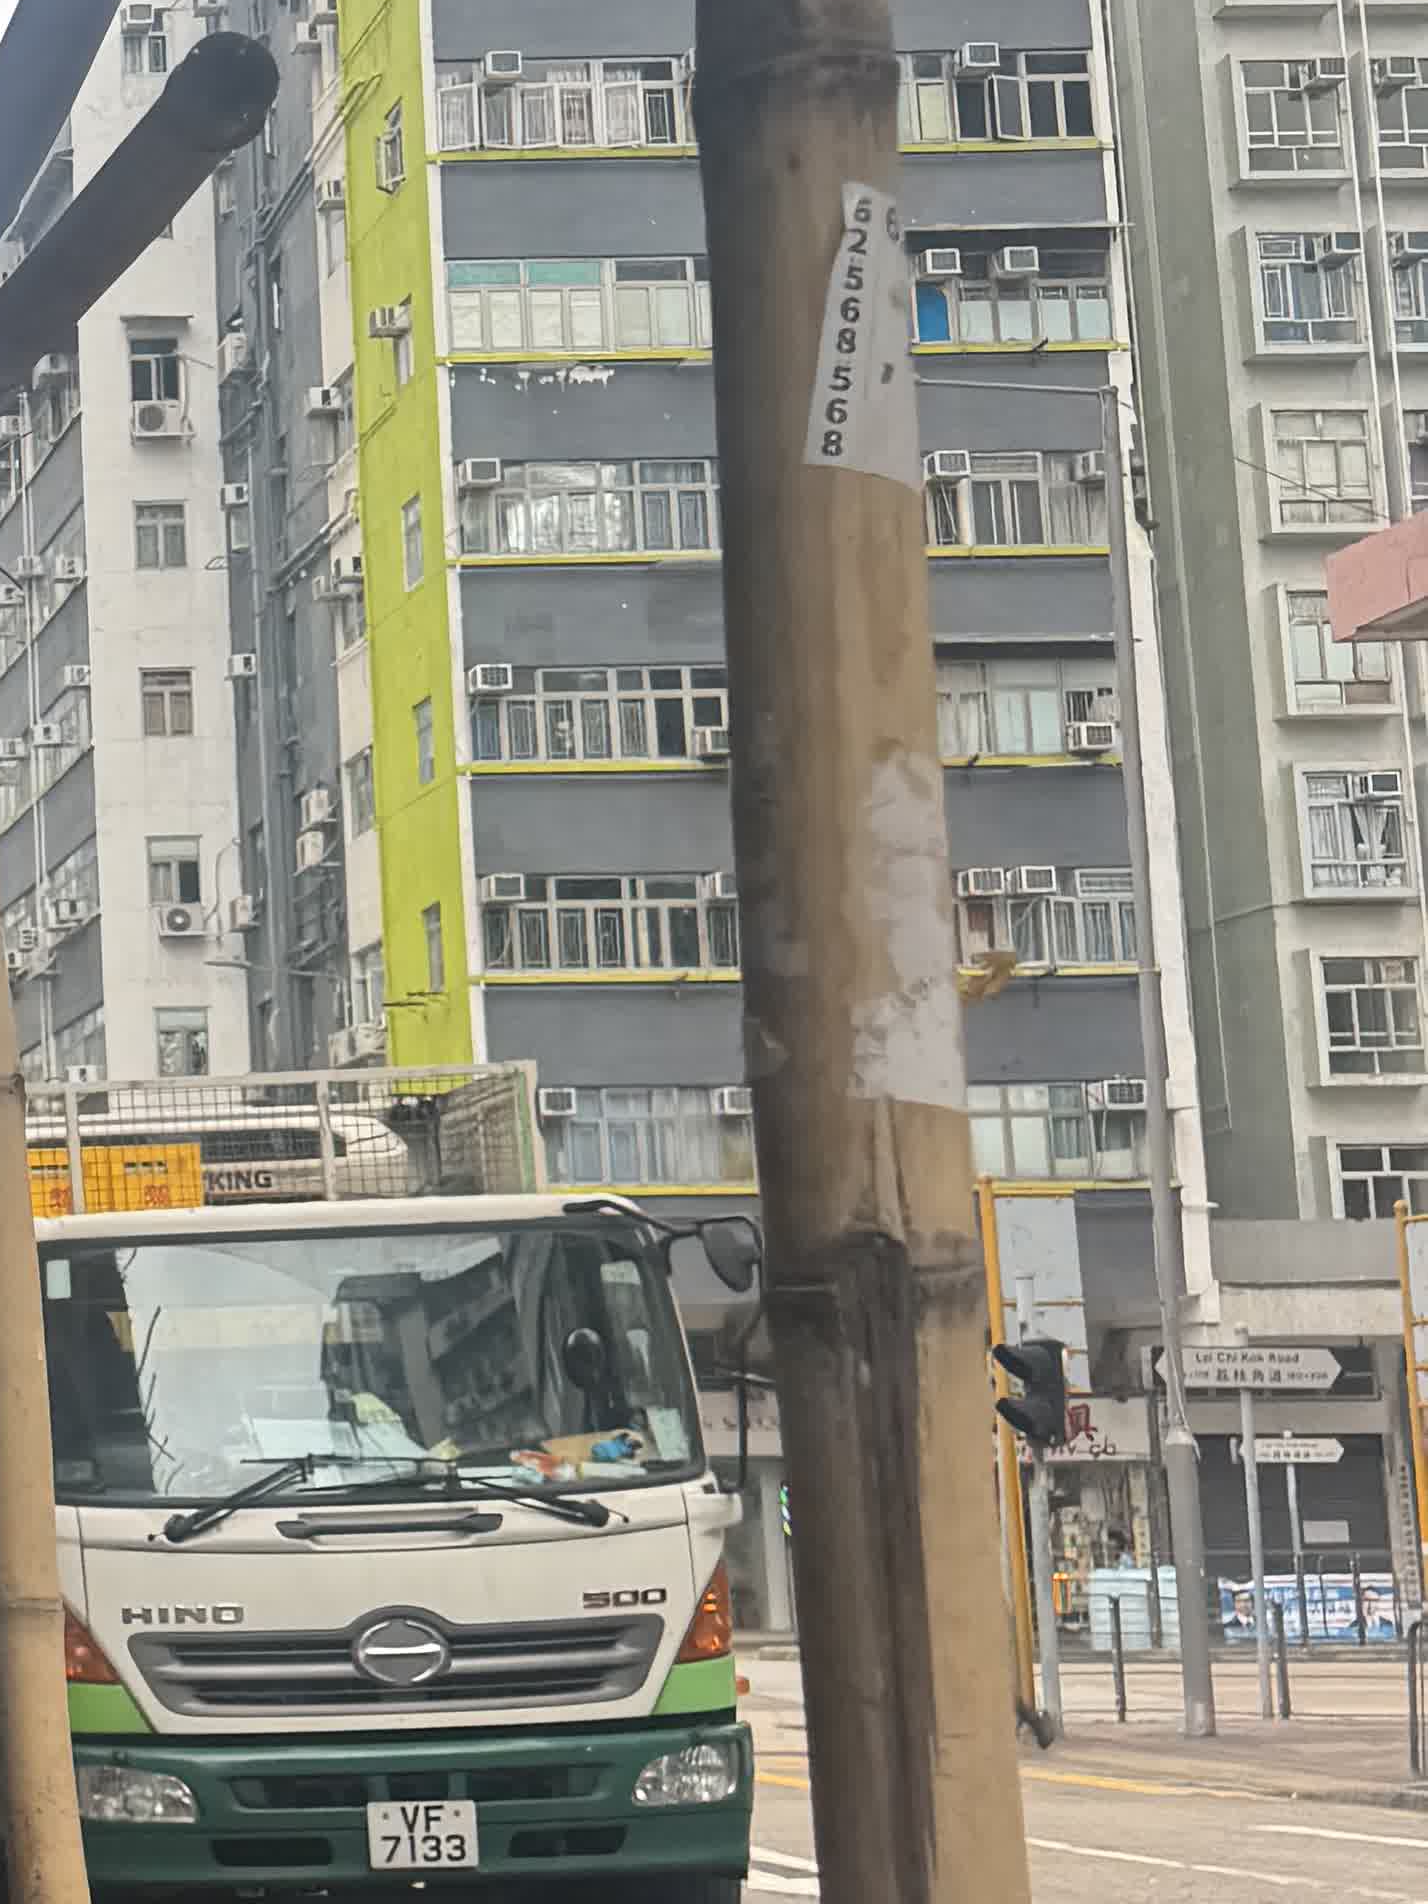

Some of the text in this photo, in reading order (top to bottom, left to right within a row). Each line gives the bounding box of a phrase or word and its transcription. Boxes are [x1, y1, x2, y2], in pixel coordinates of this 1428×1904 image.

[207, 1170, 272, 1192] KING
[582, 1588, 667, 1609] 500
[121, 1606, 244, 1625] HINO
[400, 1805, 444, 1833] VF
[381, 1835, 468, 1865] 7133
